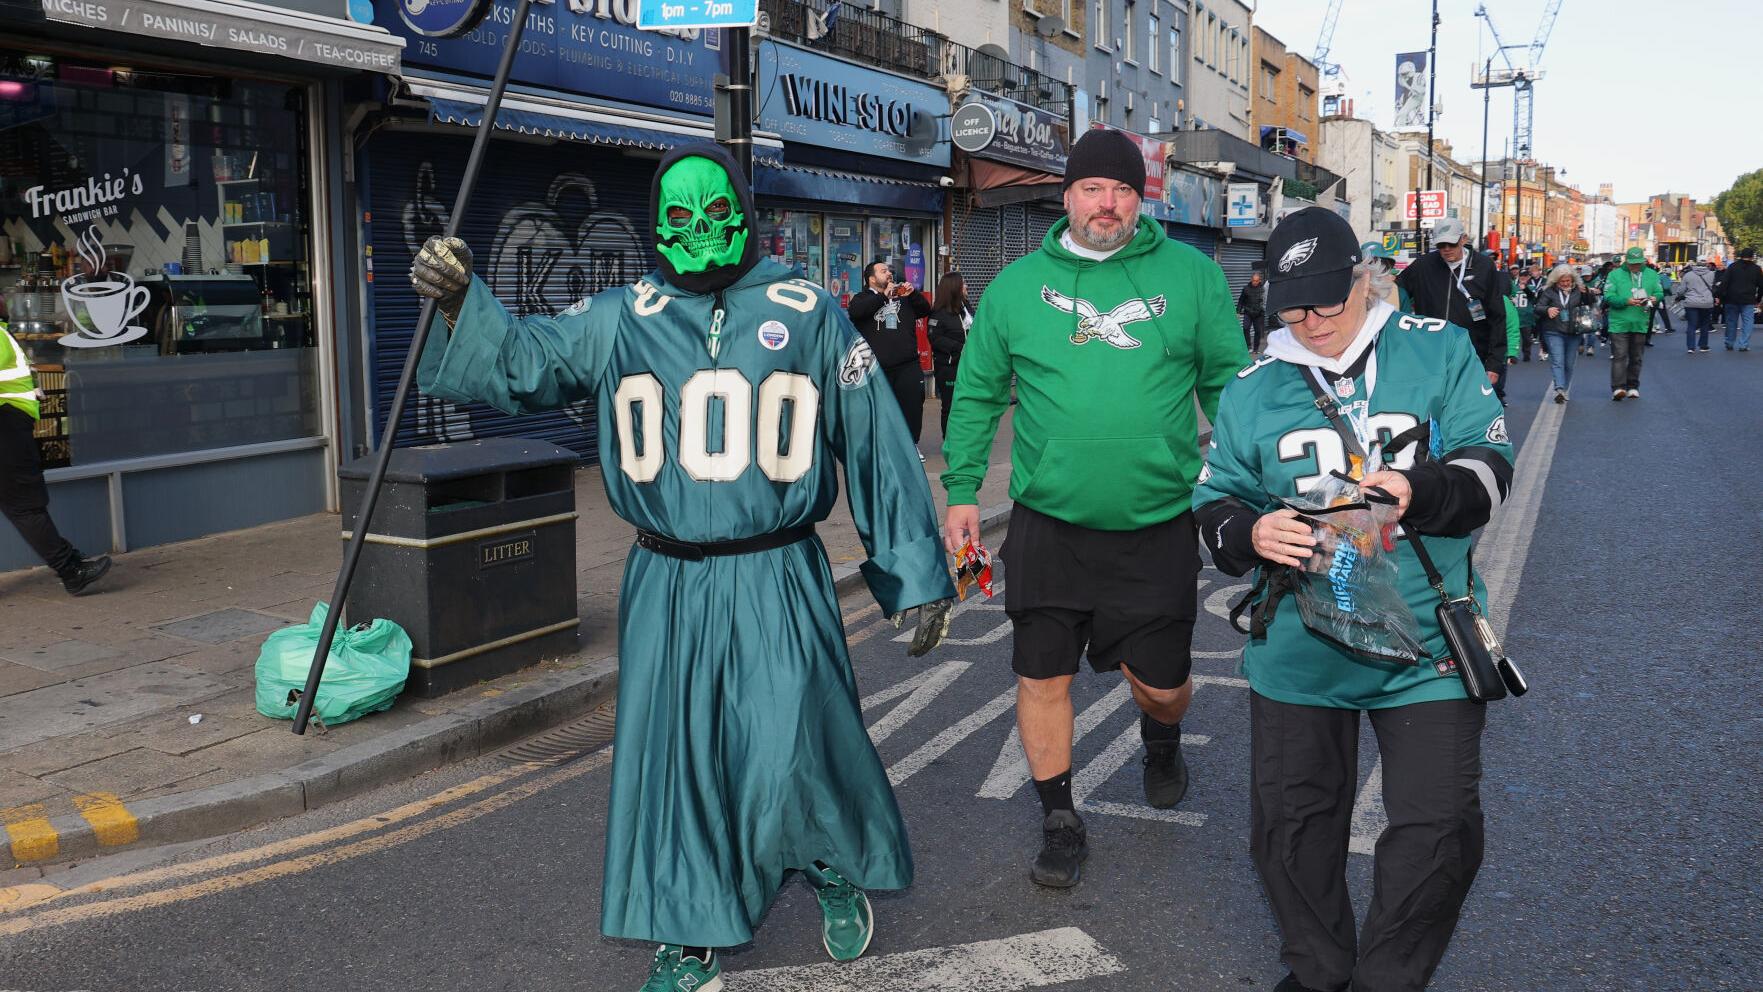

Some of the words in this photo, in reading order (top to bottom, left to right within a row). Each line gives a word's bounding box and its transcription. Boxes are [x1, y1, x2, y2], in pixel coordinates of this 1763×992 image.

[662, 3, 685, 20] 1pm
[704, 1, 733, 18] 7pm
[42, 0, 107, 21] ICHES
[229, 28, 287, 50] SALADS
[314, 43, 396, 66] TEA-COFFEE
[571, 23, 595, 43] KEY
[600, 31, 653, 57] CUTTING
[418, 41, 438, 57] 745
[560, 47, 612, 70] PLUMBING
[670, 90, 683, 103] 020
[964, 118, 979, 126] OFF
[956, 127, 989, 137] LICENCE
[25, 168, 143, 218] Frankie's
[1411, 201, 1440, 209] AEAD
[63, 208, 101, 225] SANDWICH
[104, 205, 118, 216] BAR
[485, 541, 530, 563] LITTER
